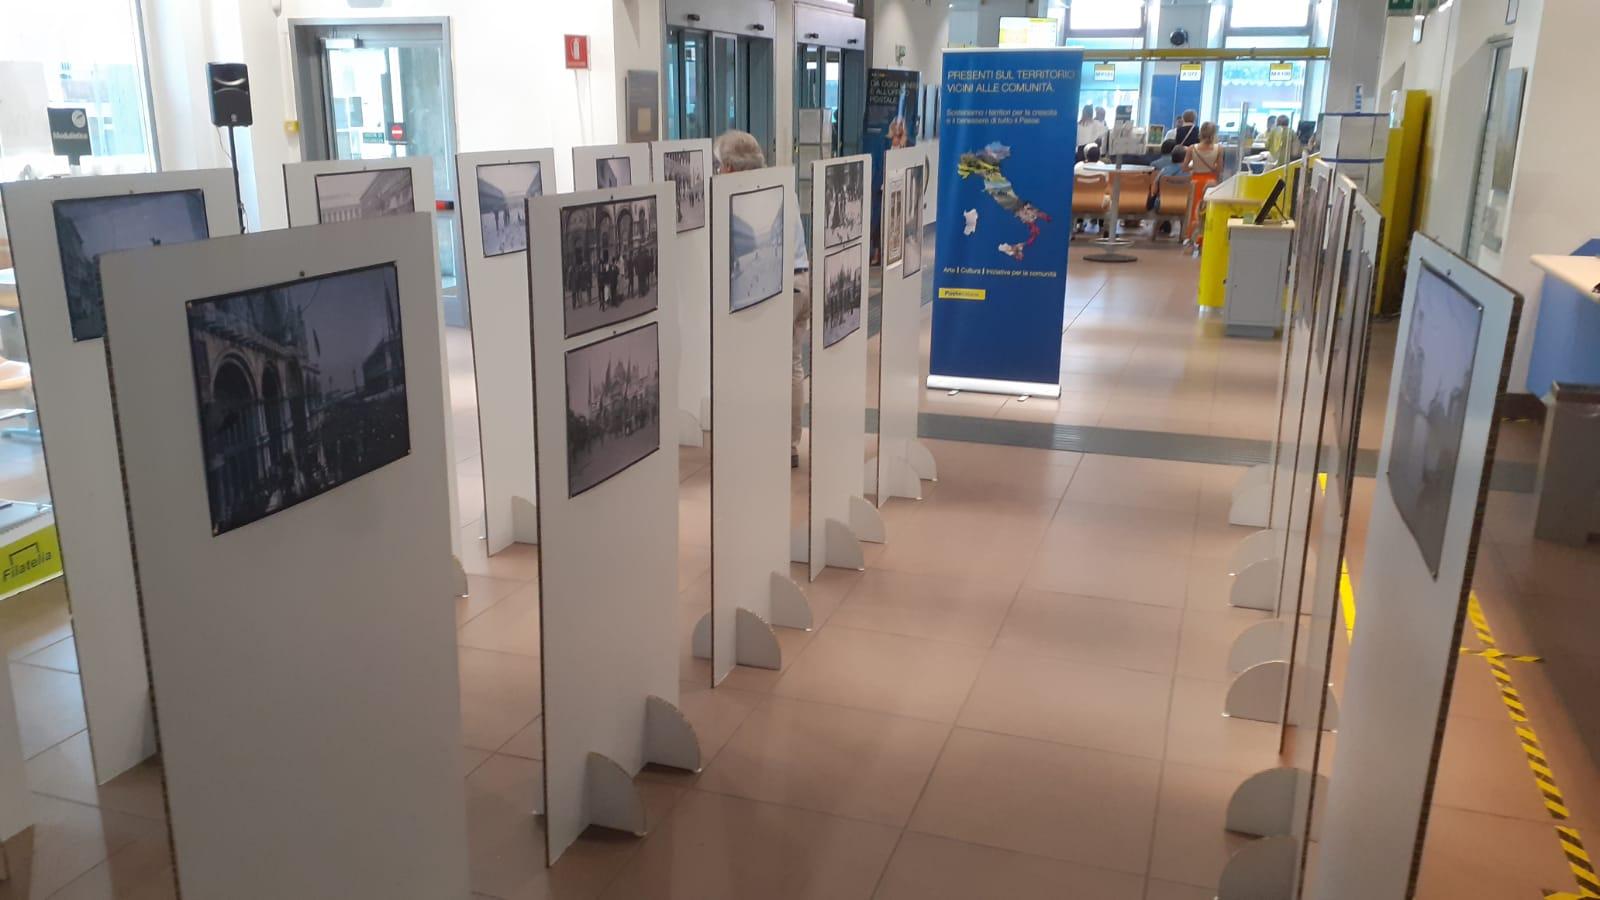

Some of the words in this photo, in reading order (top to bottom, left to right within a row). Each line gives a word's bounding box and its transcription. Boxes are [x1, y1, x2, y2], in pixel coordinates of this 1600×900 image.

[947, 69, 993, 80] PRESENTI
[995, 69, 1014, 80] SUL
[1017, 69, 1075, 80] TERRITORIO
[947, 82, 973, 93] VICINI
[975, 82, 1000, 93] ALLE
[960, 266, 981, 275] Cultura
[2, 551, 52, 582] Filatelia
